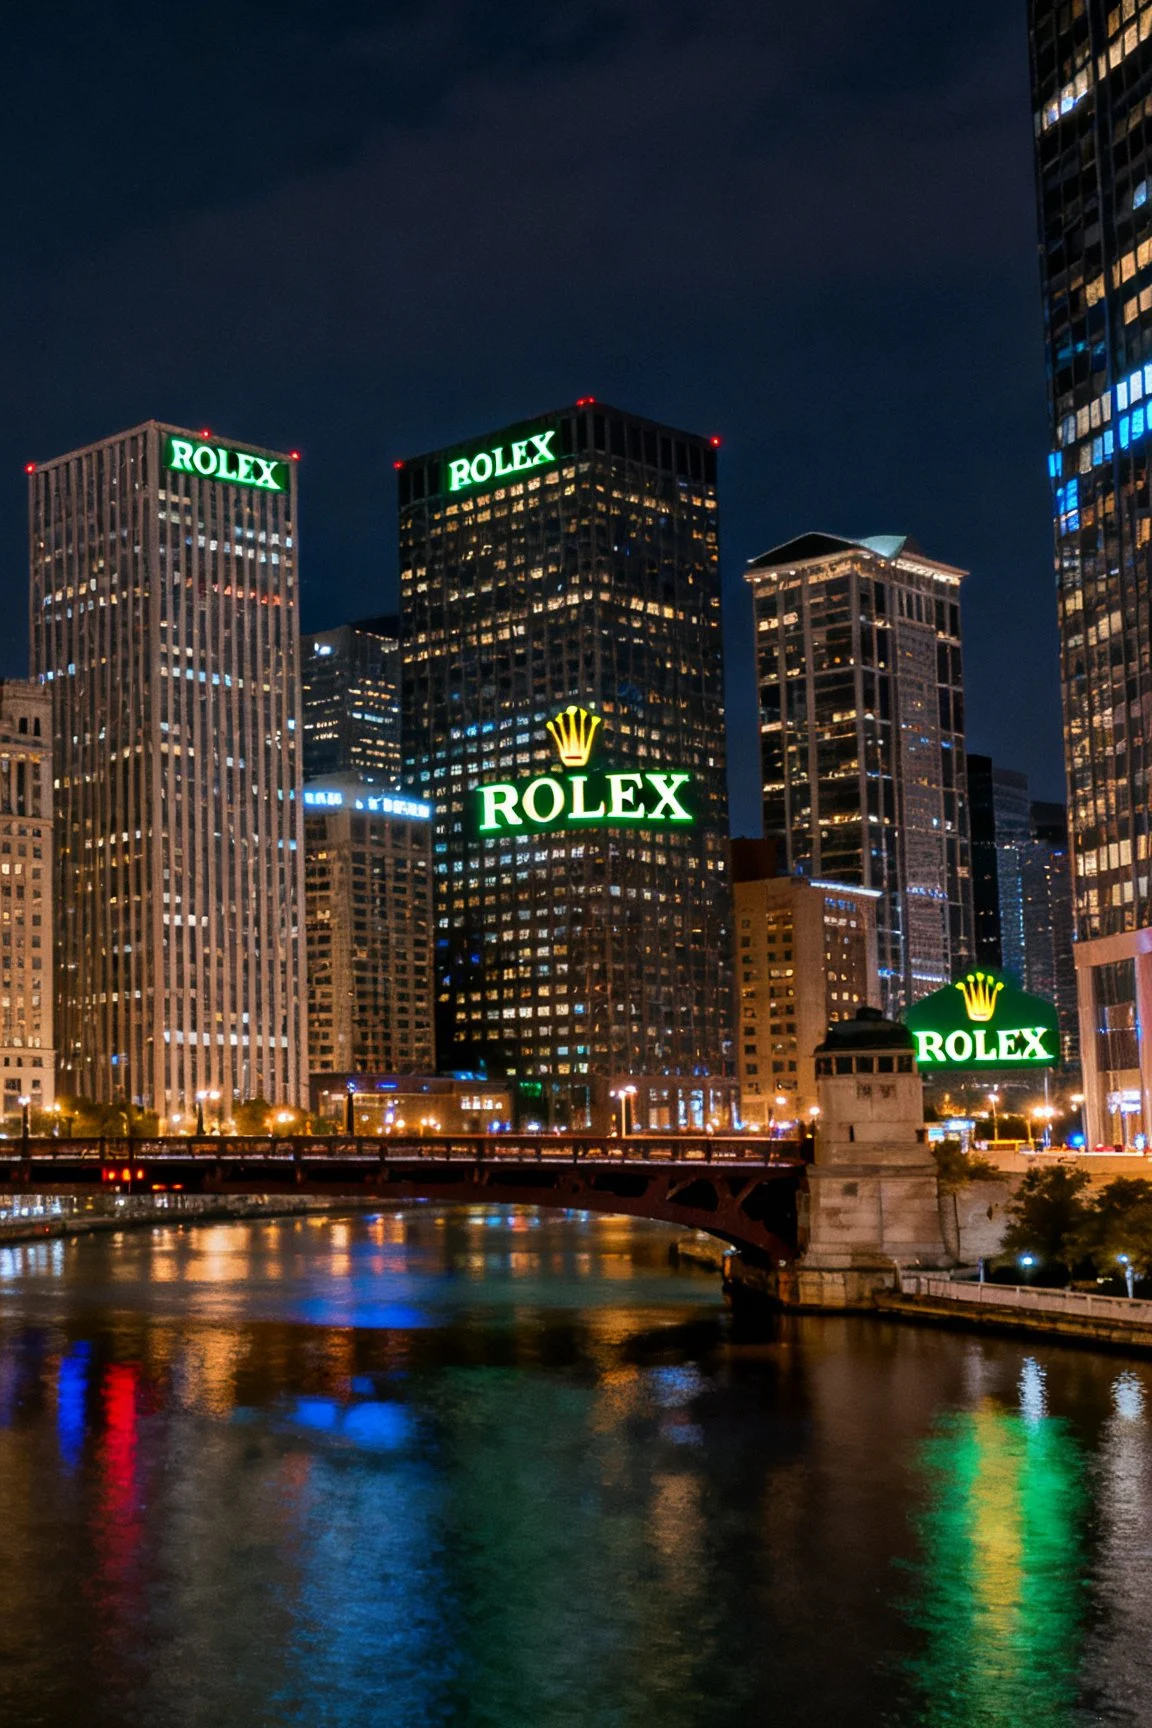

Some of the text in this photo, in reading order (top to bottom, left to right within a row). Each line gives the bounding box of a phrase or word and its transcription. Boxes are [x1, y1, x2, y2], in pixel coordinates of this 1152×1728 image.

[170, 439, 281, 489] ROLEX
[449, 431, 555, 491] ROLEX
[476, 773, 693, 830] ROLEX
[912, 1027, 1054, 1062] ROLEX
